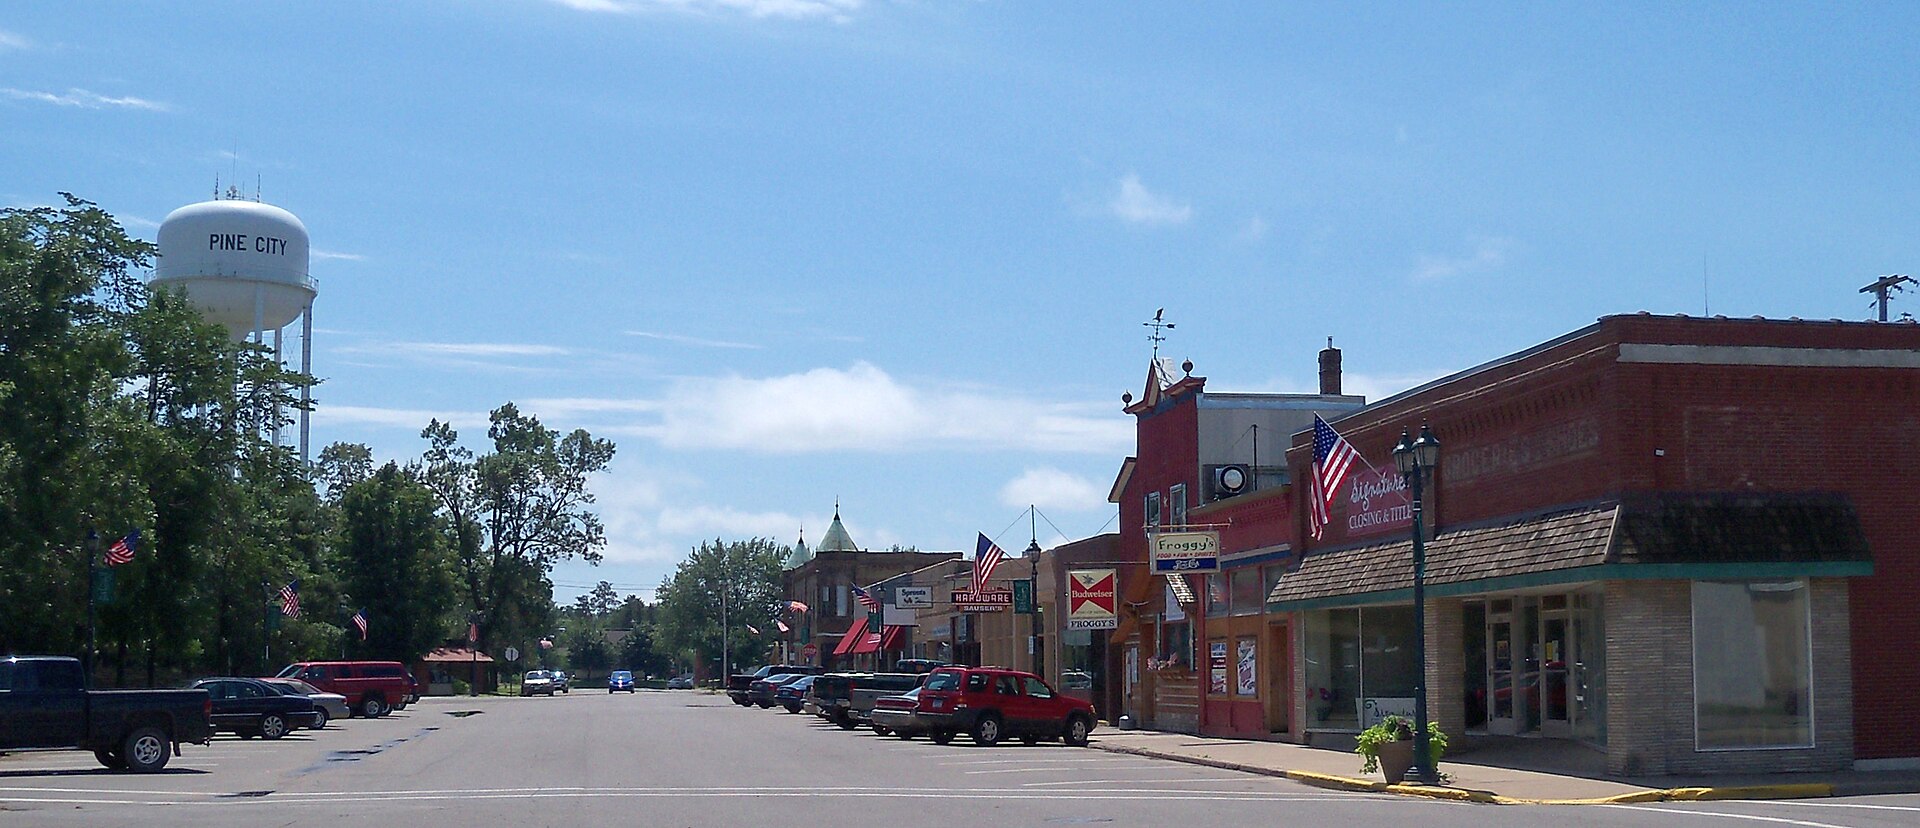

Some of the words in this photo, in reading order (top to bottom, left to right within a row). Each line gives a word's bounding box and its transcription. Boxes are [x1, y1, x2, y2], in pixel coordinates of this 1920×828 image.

[209, 233, 248, 251] PINE
[255, 236, 288, 256] CITY
[1349, 510, 1382, 529] CLOSING
[1382, 508, 1389, 523] &
[1389, 504, 1412, 521] TITLE
[1158, 537, 1215, 552] Froggy's
[955, 593, 1010, 603] HARDWARE
[1071, 590, 1114, 598] Budweiser
